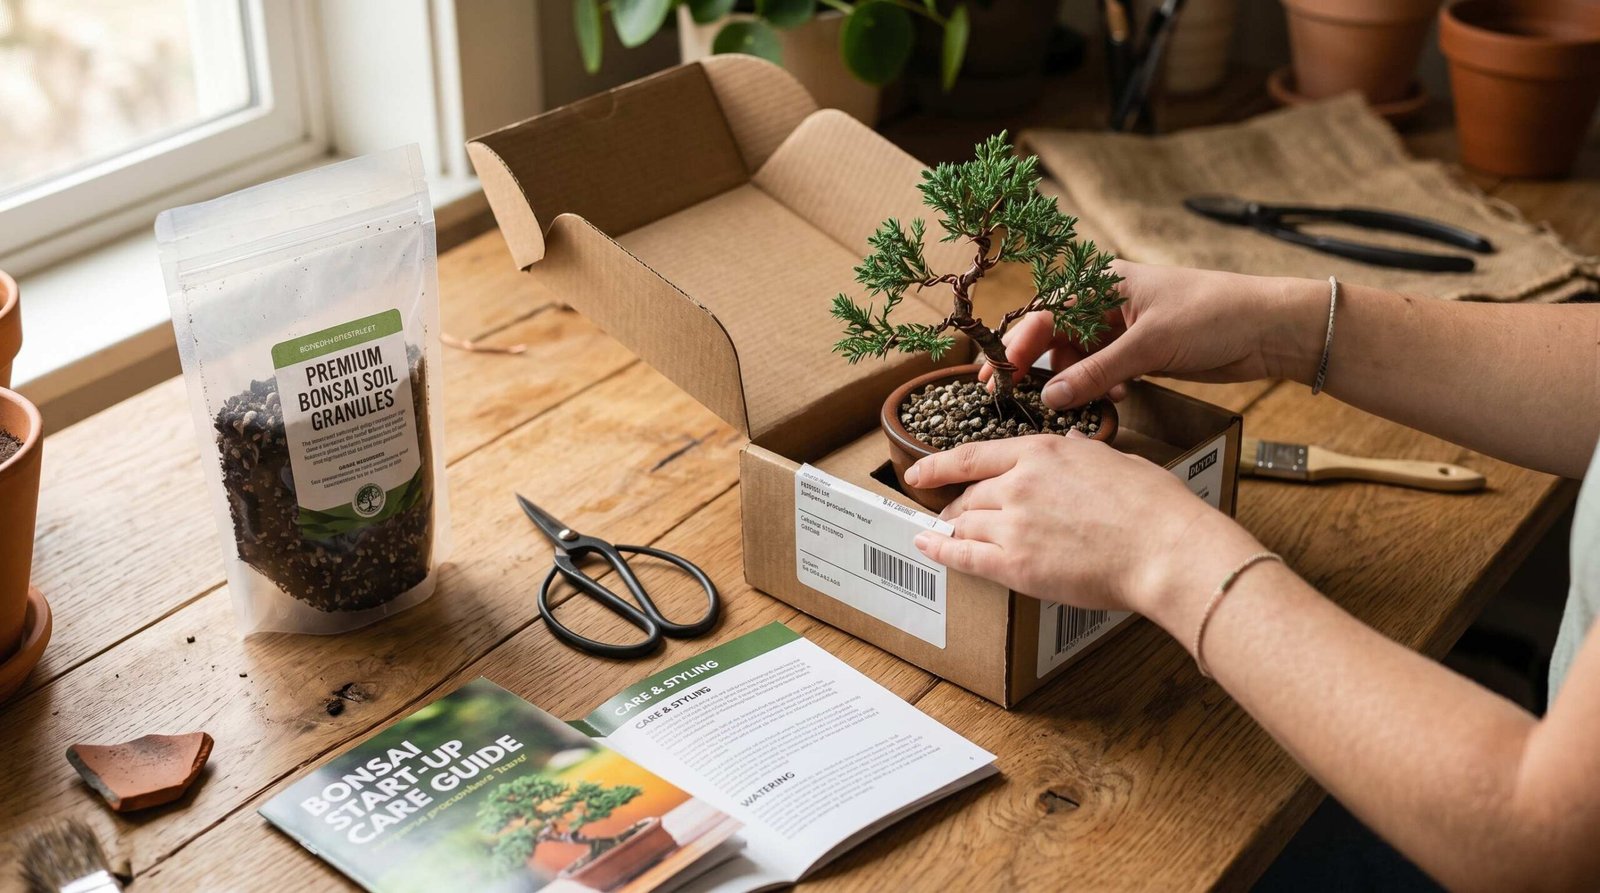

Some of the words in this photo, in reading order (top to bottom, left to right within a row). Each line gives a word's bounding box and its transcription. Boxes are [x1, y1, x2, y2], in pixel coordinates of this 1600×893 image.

[298, 376, 360, 413] BONSAI
[362, 365, 398, 392] SOIL
[305, 345, 383, 387] PREMIUM
[311, 388, 394, 431] GRANULES
[615, 692, 652, 716] CARE
[651, 686, 665, 695] &
[663, 660, 719, 688] STYLING
[635, 711, 663, 729] CARE
[662, 706, 672, 714] &
[300, 740, 422, 817] BONSAI
[325, 739, 463, 831] START-UP
[347, 788, 434, 844] CARE
[430, 734, 524, 791] GUIDE
[741, 771, 796, 807] WATERING
